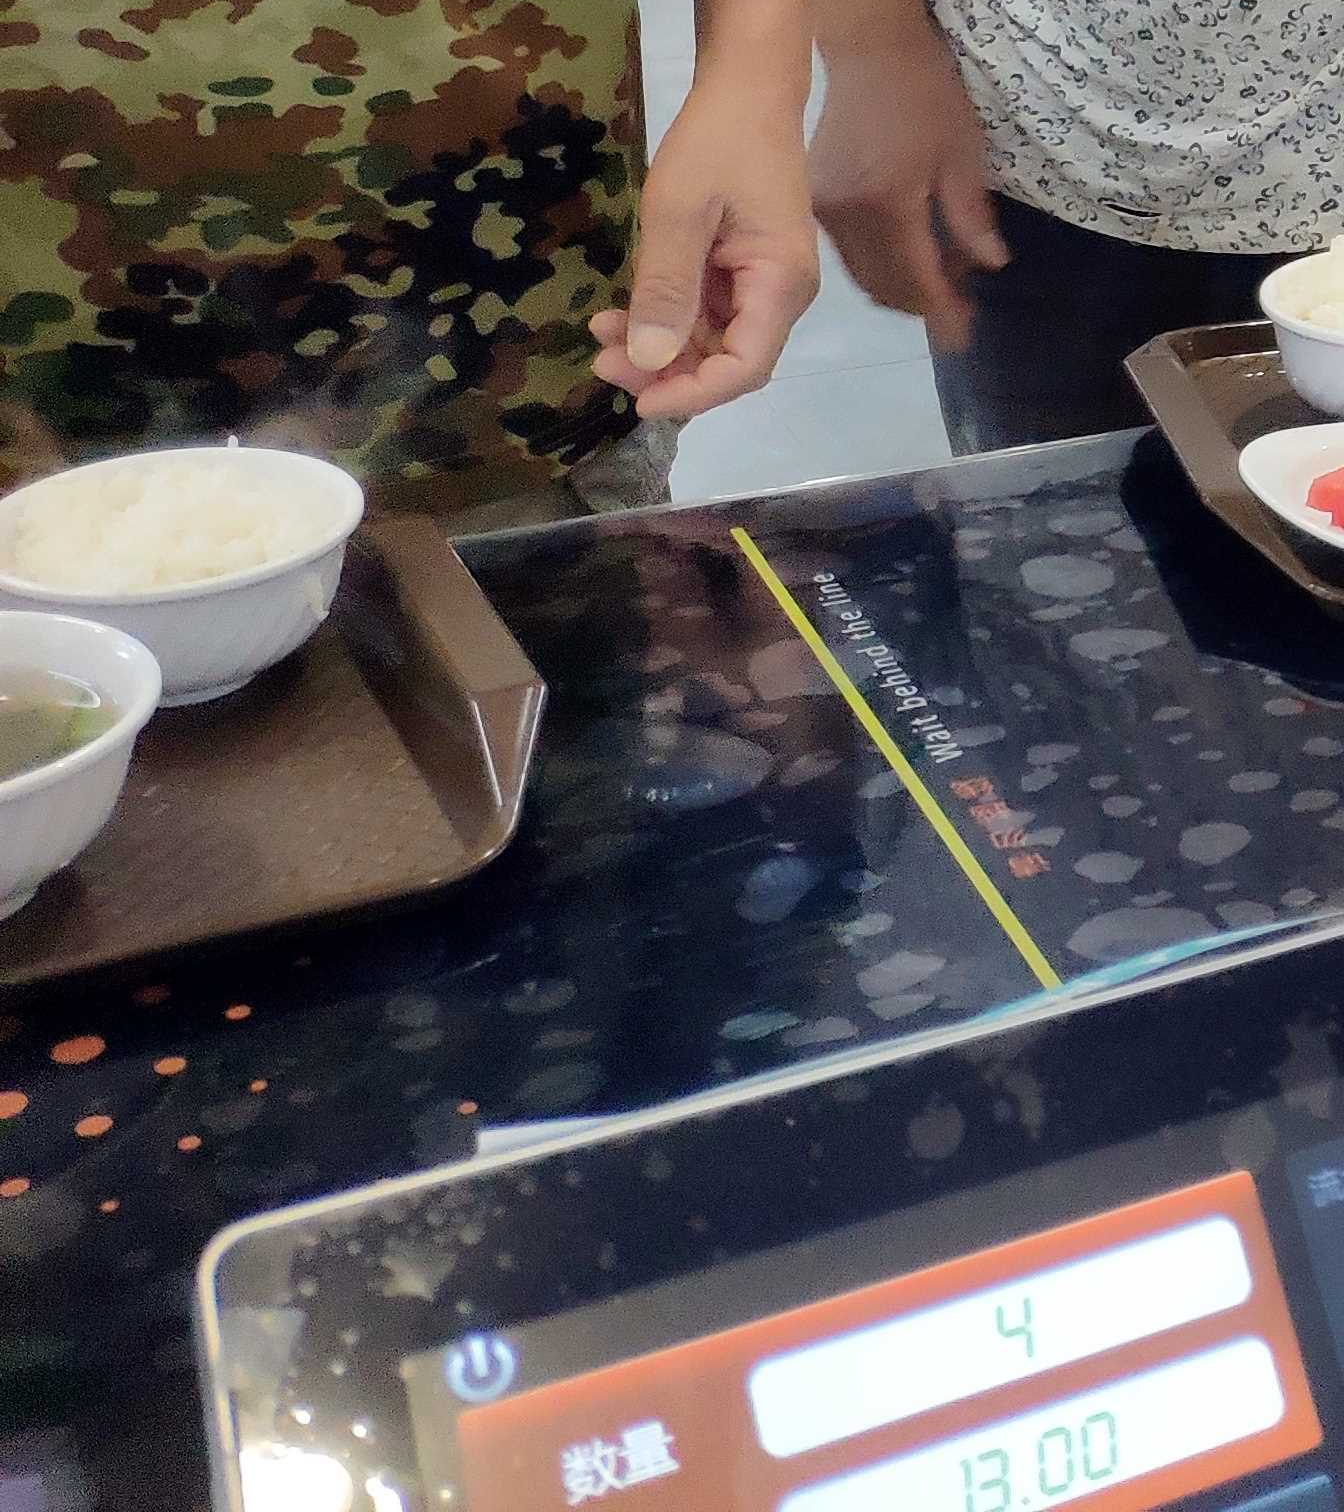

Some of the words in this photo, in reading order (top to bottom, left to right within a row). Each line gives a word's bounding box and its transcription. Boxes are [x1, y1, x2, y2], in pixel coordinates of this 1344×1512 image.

[814, 573, 852, 606] line
[841, 610, 875, 639] the
[856, 644, 927, 711] behind
[912, 714, 963, 763] Wait
[996, 1297, 1034, 1358] 4
[560, 1420, 681, 1507] 数量
[960, 1411, 1117, 1512] 13.00
